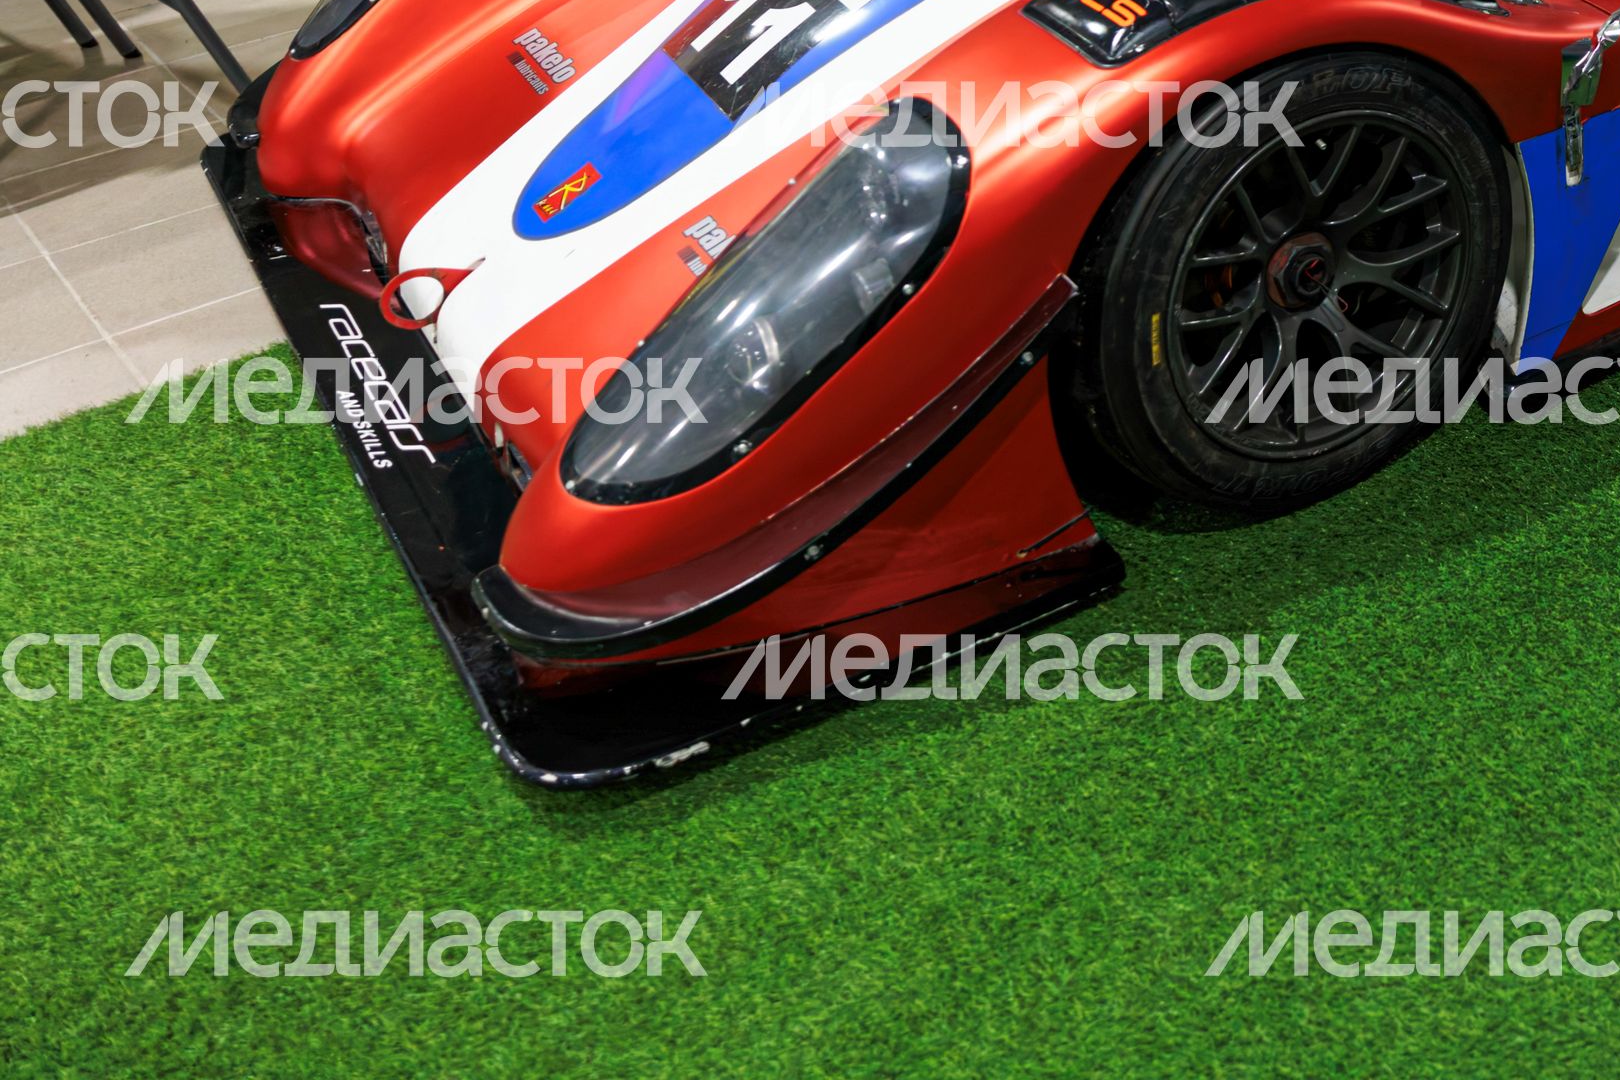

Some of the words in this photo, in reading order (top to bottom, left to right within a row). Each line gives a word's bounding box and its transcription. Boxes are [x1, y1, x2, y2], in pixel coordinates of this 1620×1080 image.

[512, 27, 576, 83] pakelo
[336, 390, 364, 418] AND
[352, 420, 393, 469] SKILLS
